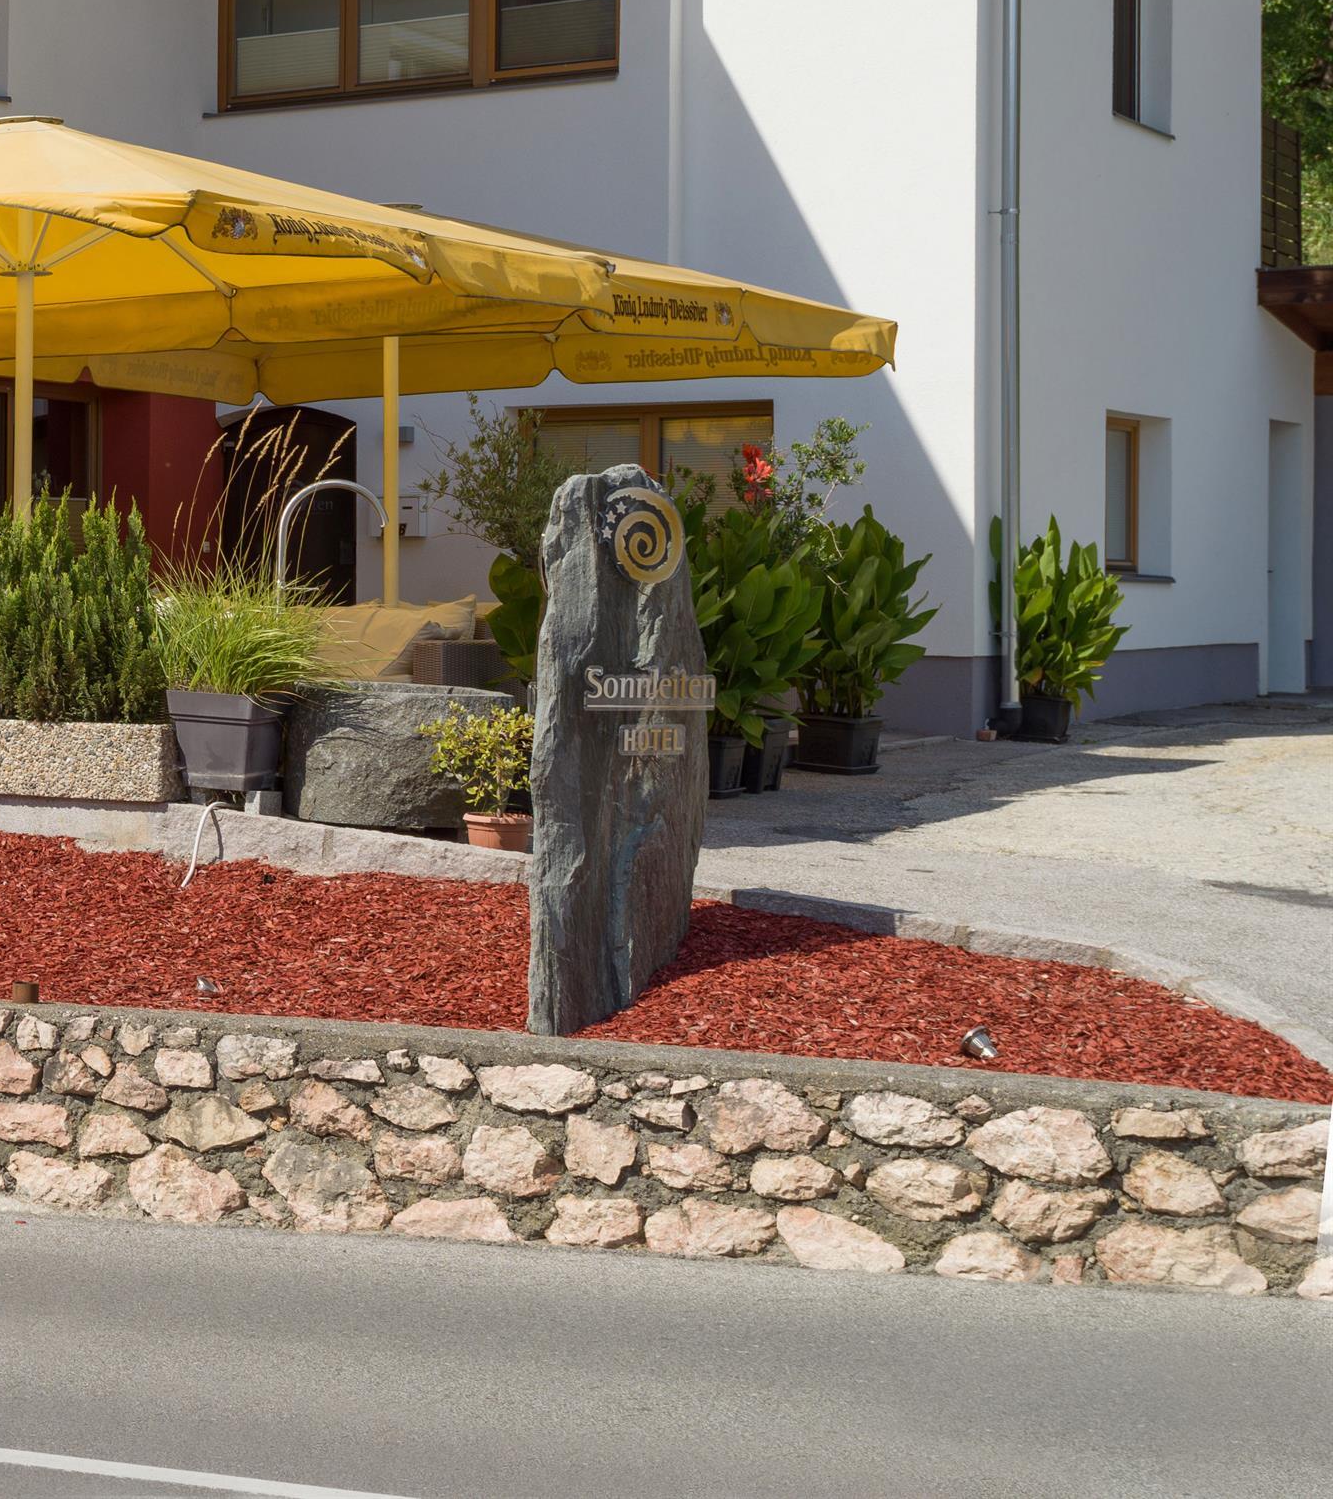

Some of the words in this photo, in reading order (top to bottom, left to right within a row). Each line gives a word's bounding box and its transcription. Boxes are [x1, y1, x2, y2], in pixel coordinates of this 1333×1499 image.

[636, 295, 668, 325] Ludwig
[668, 297, 708, 323] Weissbier
[587, 667, 716, 700] Sonnleiten
[624, 729, 683, 752] HOTEL
